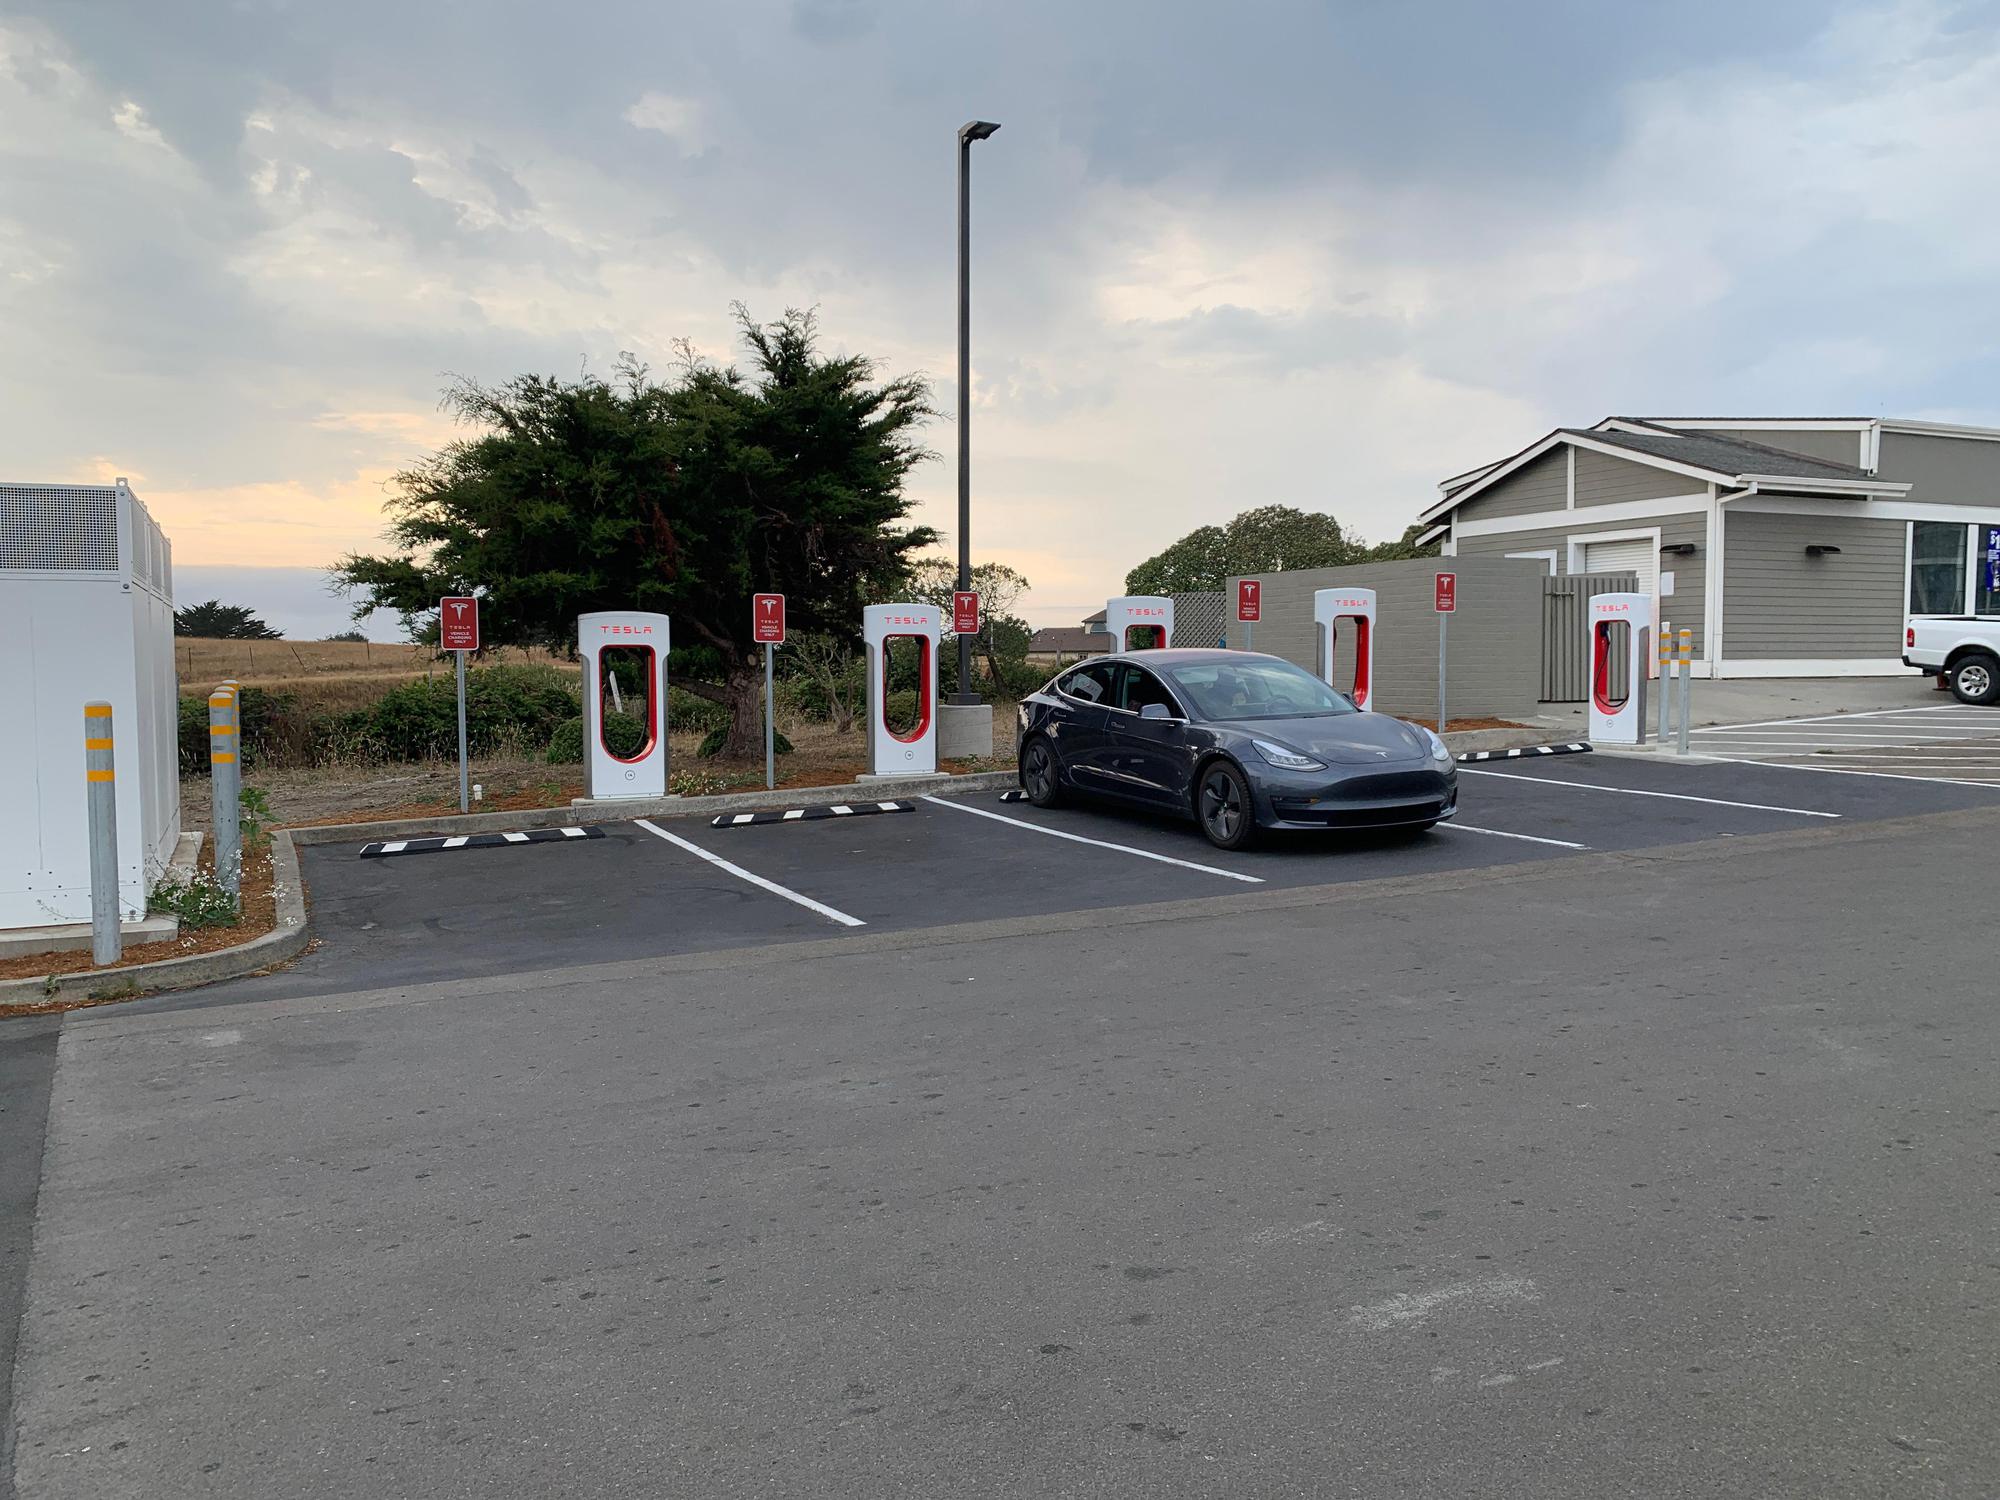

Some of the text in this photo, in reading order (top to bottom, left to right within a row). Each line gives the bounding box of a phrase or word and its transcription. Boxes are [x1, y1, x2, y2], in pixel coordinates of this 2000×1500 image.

[1335, 599, 1368, 607] TESLA
[1127, 608, 1164, 616] TESLA
[1595, 604, 1629, 612] TESLA
[884, 616, 928, 625] TESLA
[601, 625, 652, 634] TESLA
